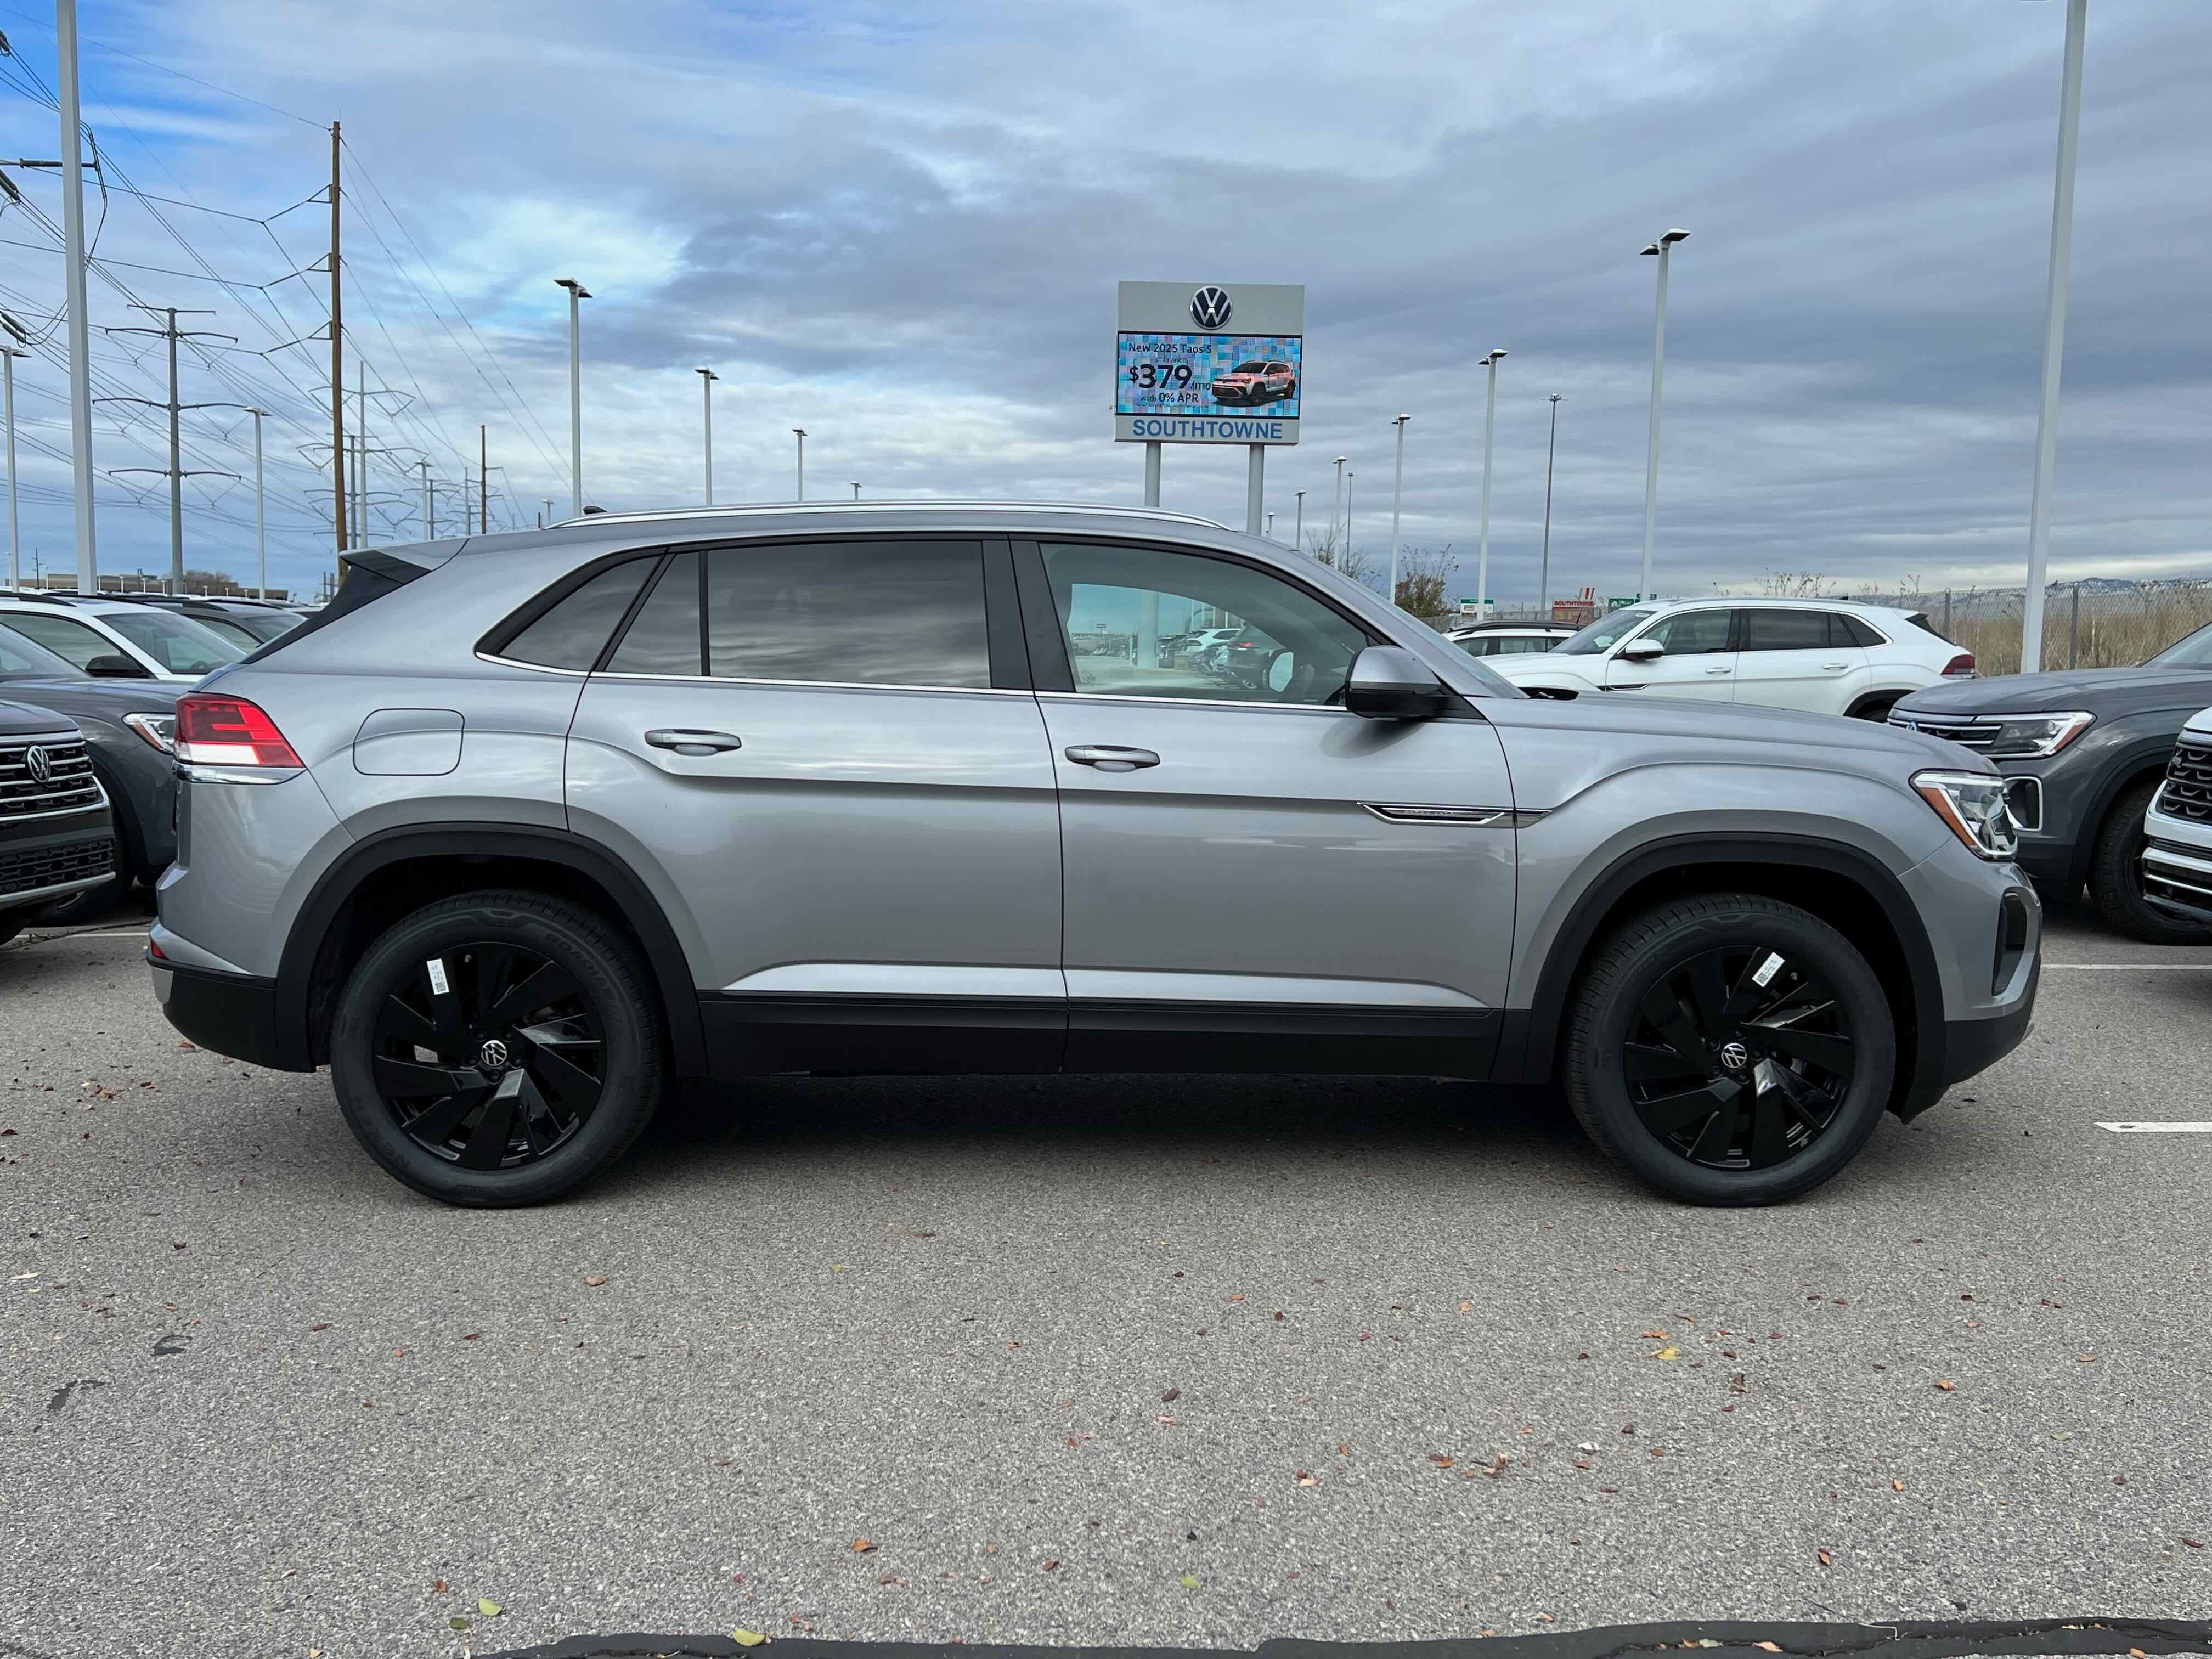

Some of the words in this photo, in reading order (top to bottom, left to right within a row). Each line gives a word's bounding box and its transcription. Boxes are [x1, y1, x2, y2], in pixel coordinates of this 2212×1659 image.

[1190, 286, 1233, 330] VW
[1128, 342, 1150, 352] New
[1154, 343, 1178, 353] 2025
[1181, 343, 1204, 353] Taos
[1158, 392, 1175, 403] 0%
[1177, 393, 1199, 403] APR
[1132, 419, 1283, 439] SOUTHTOWNE
